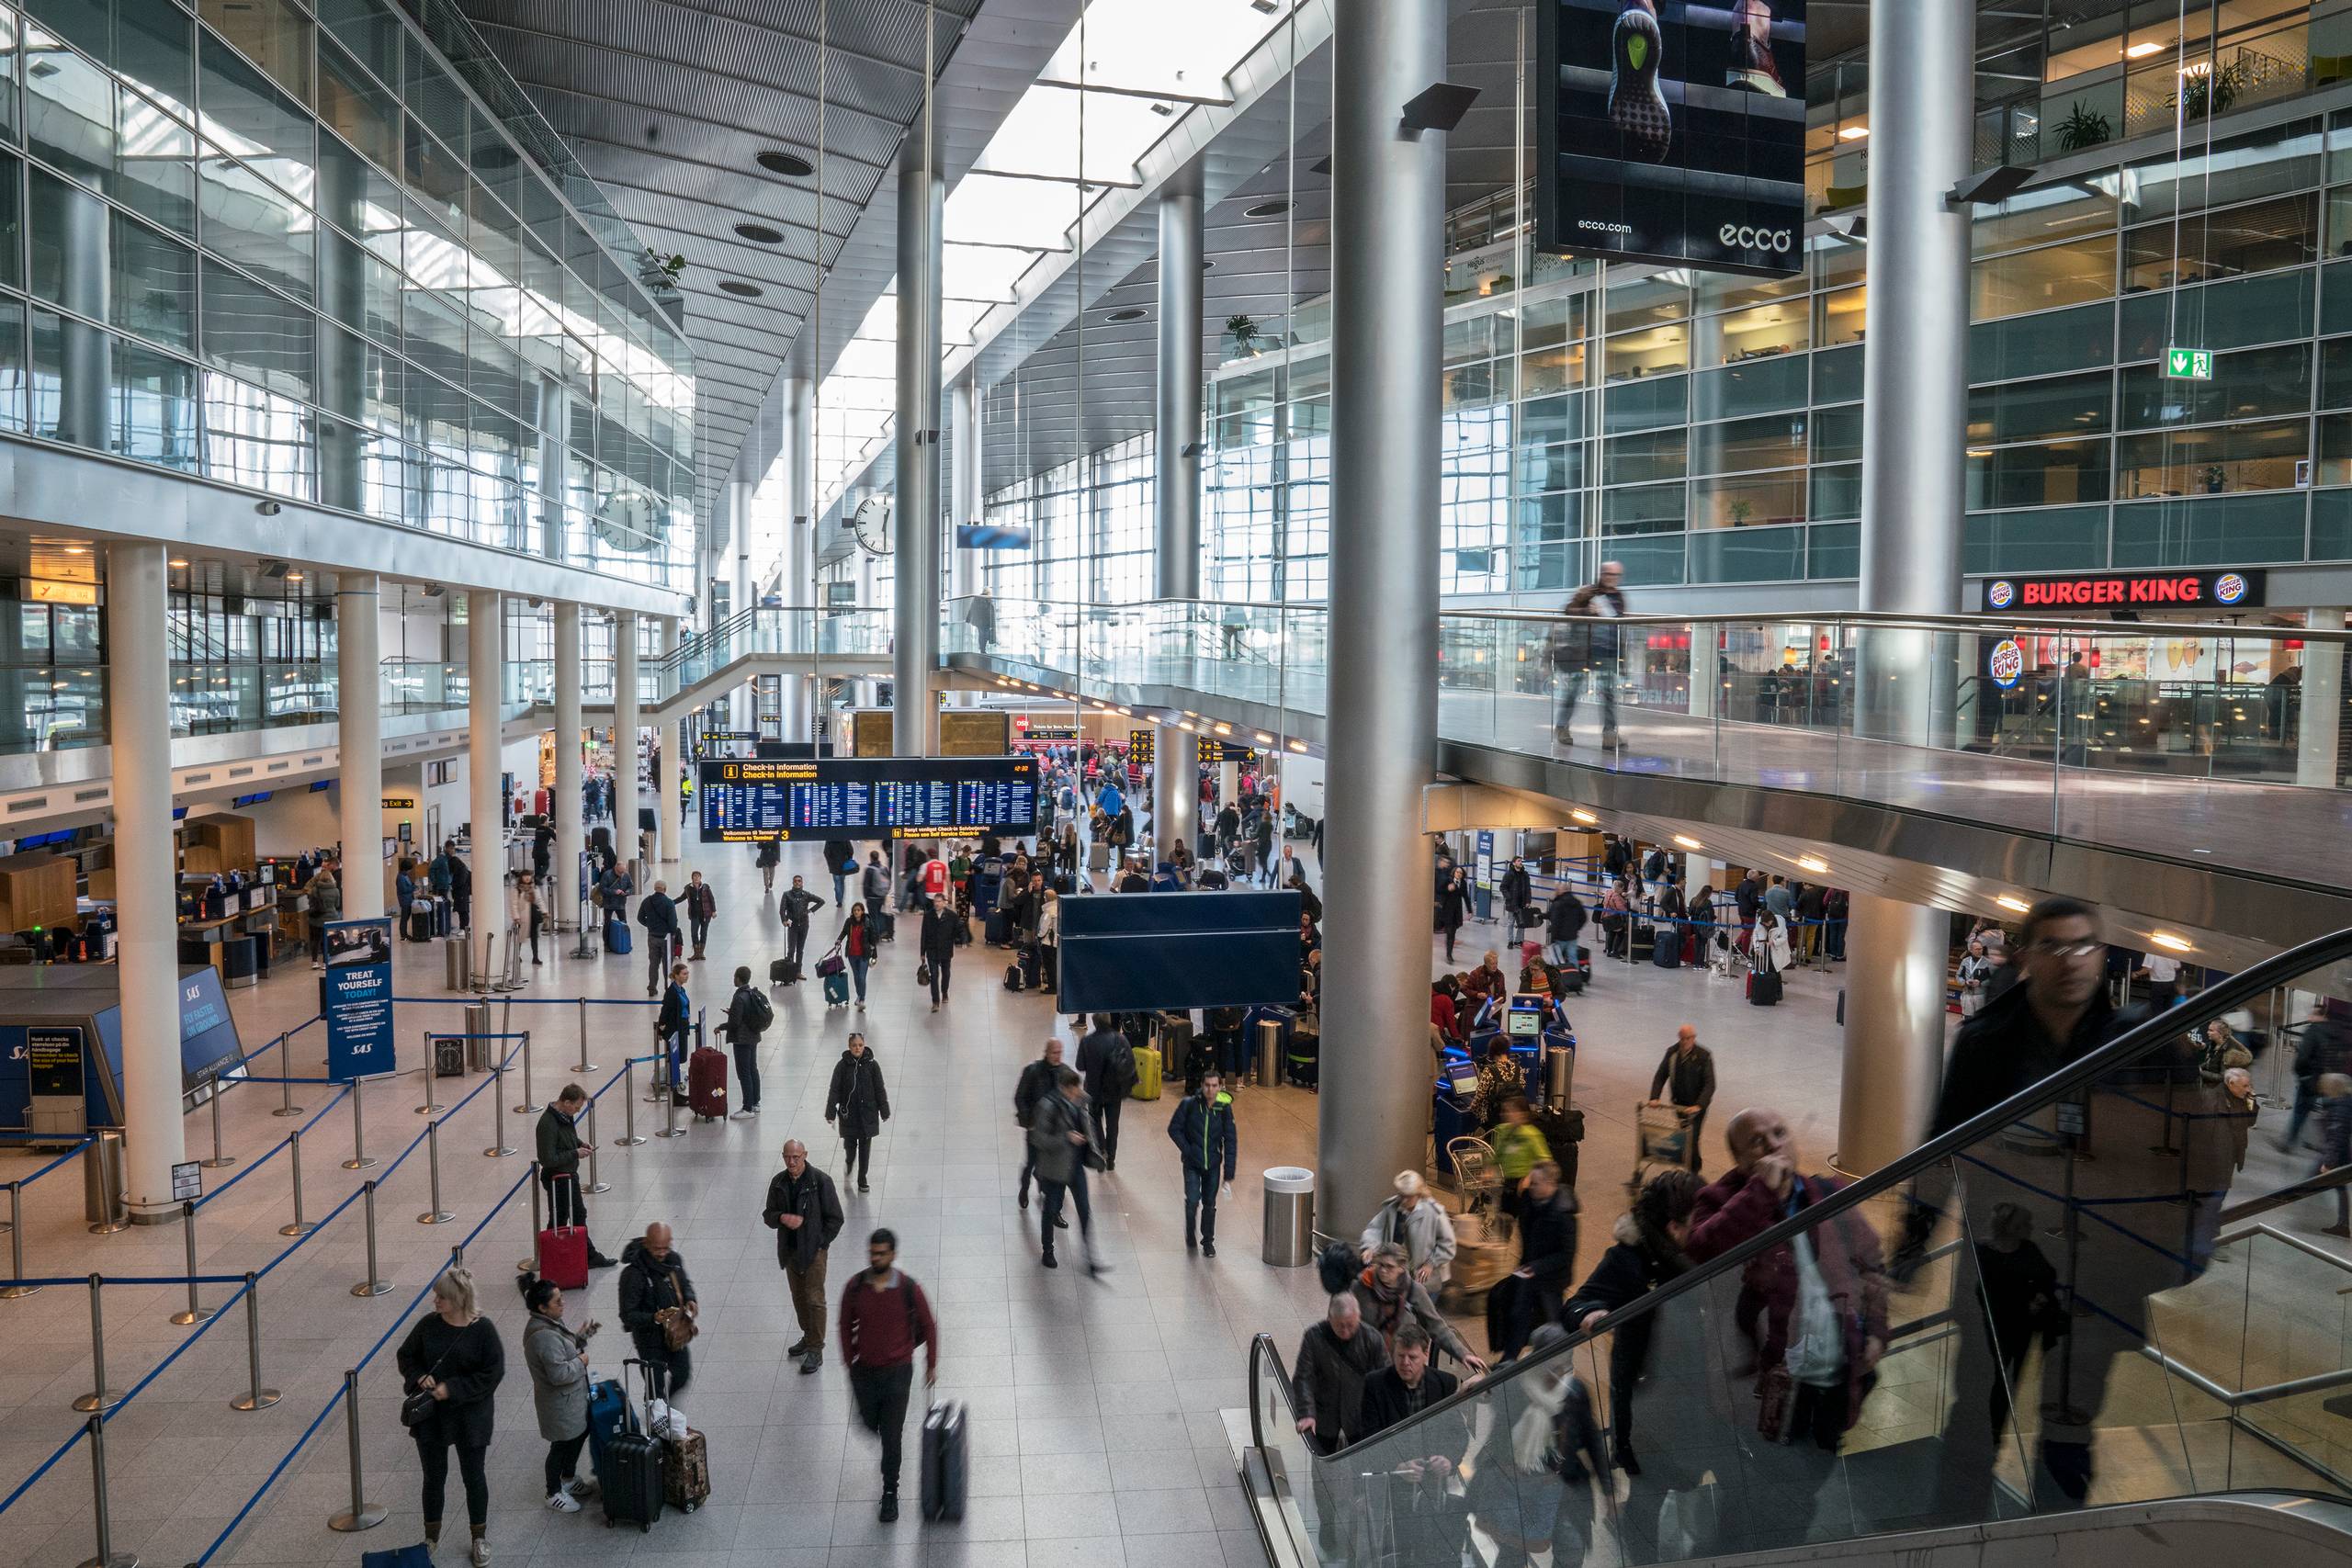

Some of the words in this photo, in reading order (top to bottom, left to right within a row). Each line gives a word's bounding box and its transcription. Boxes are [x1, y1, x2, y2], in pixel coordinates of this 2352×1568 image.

[1577, 220, 1632, 233] ecco.com
[1719, 223, 1792, 253] ecco
[1992, 585, 2010, 594] BURGER
[2218, 577, 2241, 590] BURGER
[1992, 590, 2011, 602] KING
[2024, 580, 2124, 604] BURGER
[2129, 578, 2200, 603] KING
[2219, 584, 2242, 597] KING
[1993, 648, 2018, 665] BURGER
[1994, 657, 2019, 678] KING
[781, 830, 789, 840] 3
[345, 970, 373, 980] TREAT
[338, 978, 383, 990] YOURSELF
[186, 985, 200, 1001] SAS
[345, 989, 376, 999] TODAY!
[9, 1046, 29, 1059] SA
[351, 1043, 373, 1055] SAS
